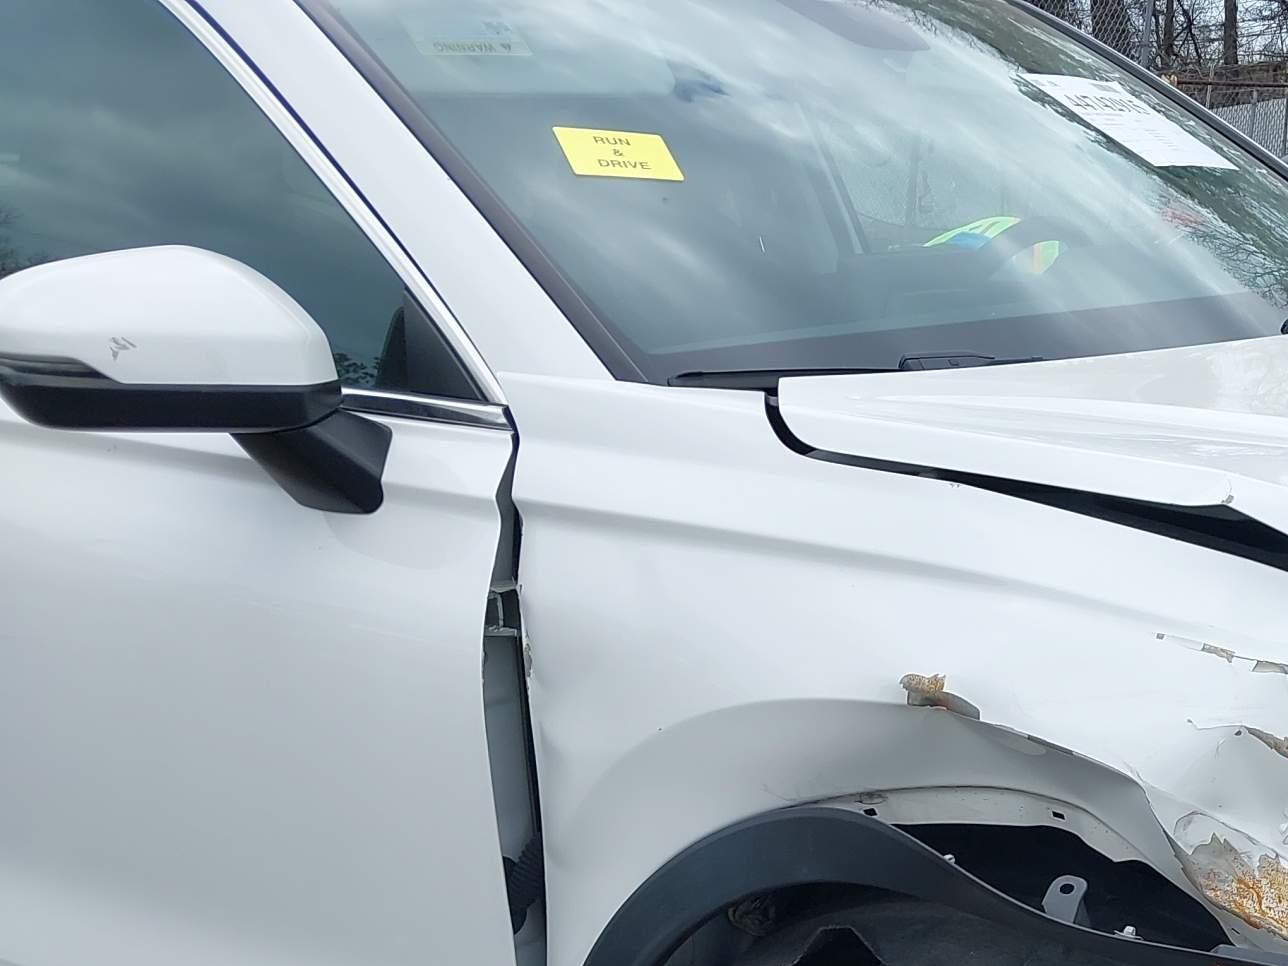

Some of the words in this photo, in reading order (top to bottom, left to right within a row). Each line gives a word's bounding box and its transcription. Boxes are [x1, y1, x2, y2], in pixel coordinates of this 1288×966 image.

[592, 136, 631, 146] RUN
[613, 148, 623, 157] &
[597, 159, 651, 170] DRIVE
